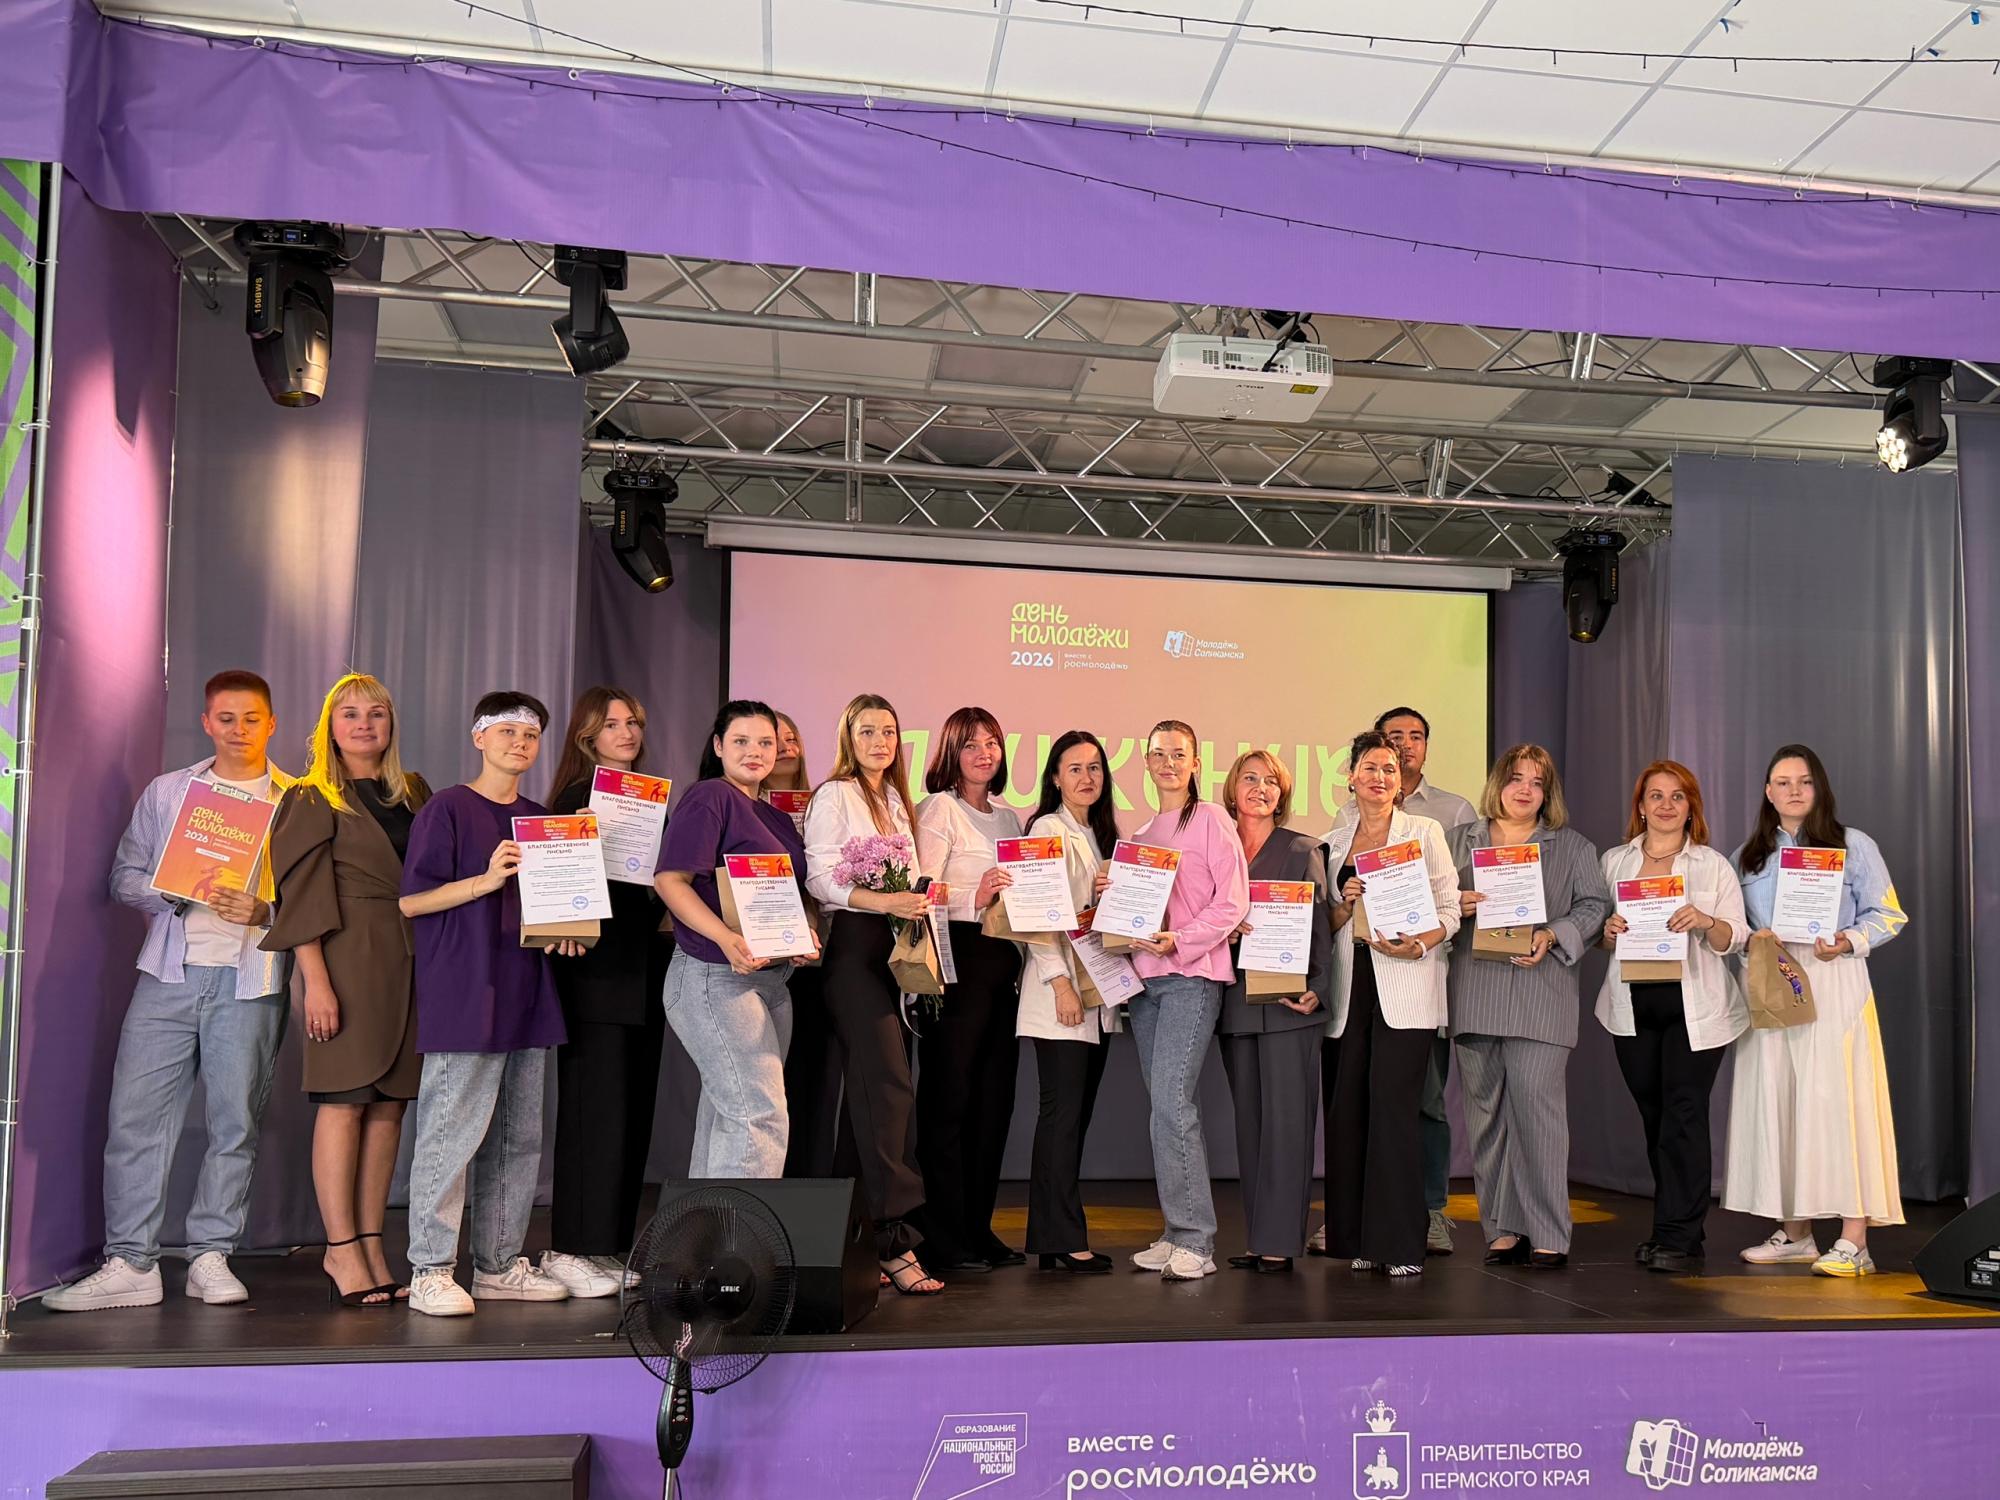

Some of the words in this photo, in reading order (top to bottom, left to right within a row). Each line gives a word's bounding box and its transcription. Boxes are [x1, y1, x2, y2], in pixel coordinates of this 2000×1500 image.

[1010, 651, 1054, 667] 2026
[184, 829, 209, 843] 2026
[955, 1424, 1016, 1434] ОБРАЗОВАНИЕ
[943, 1440, 1013, 1454] НАЦИОНАЛЬНЫЕ
[1068, 1434, 1153, 1453] вместе
[1162, 1434, 1175, 1450] с
[1421, 1442, 1582, 1462] ПРАВИТЕЛЬСТВО
[1703, 1436, 1804, 1460] Молодёжь
[973, 1452, 1013, 1463] ПРОЕКТЫ
[980, 1463, 1013, 1474] РОССИИ
[1700, 1463, 1818, 1483] Соликамска
[1067, 1457, 1317, 1500] росмолодёжь
[1421, 1470, 1537, 1489] ПЕРМСКОГО
[1543, 1469, 1590, 1487] КРАЯ
